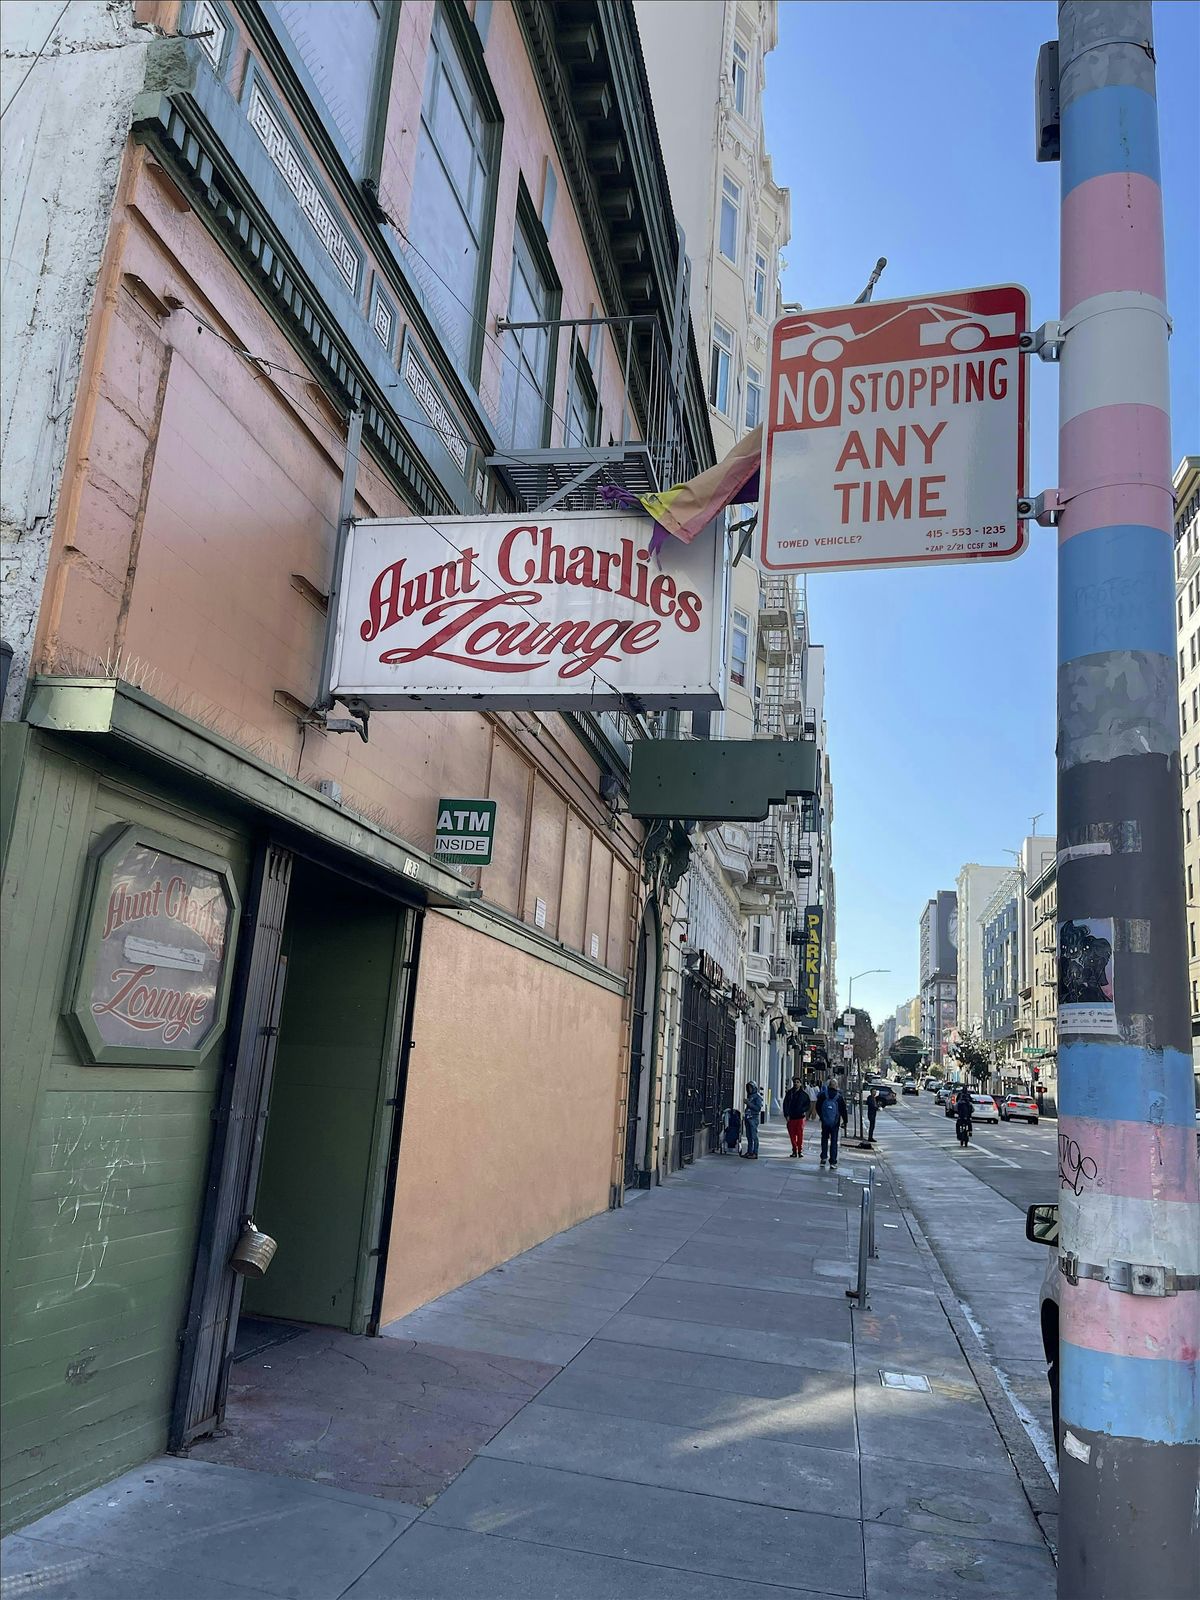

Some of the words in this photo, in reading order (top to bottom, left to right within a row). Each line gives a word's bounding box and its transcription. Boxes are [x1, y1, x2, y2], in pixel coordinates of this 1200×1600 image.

[776, 367, 836, 425] NO
[847, 357, 1008, 416] STOPPING
[834, 421, 948, 473] ANY
[833, 475, 947, 525] TIME
[777, 539, 809, 549] TOWED
[814, 535, 862, 546] VEHICLE?
[360, 547, 481, 642] Aunt
[497, 525, 703, 633] Charlies
[378, 590, 662, 679] Lounge
[435, 838, 486, 851] INSIDE
[436, 810, 490, 832] ATM
[101, 880, 163, 941] Aunt
[805, 914, 820, 1018] PARKING
[92, 965, 209, 1045] Lounge
